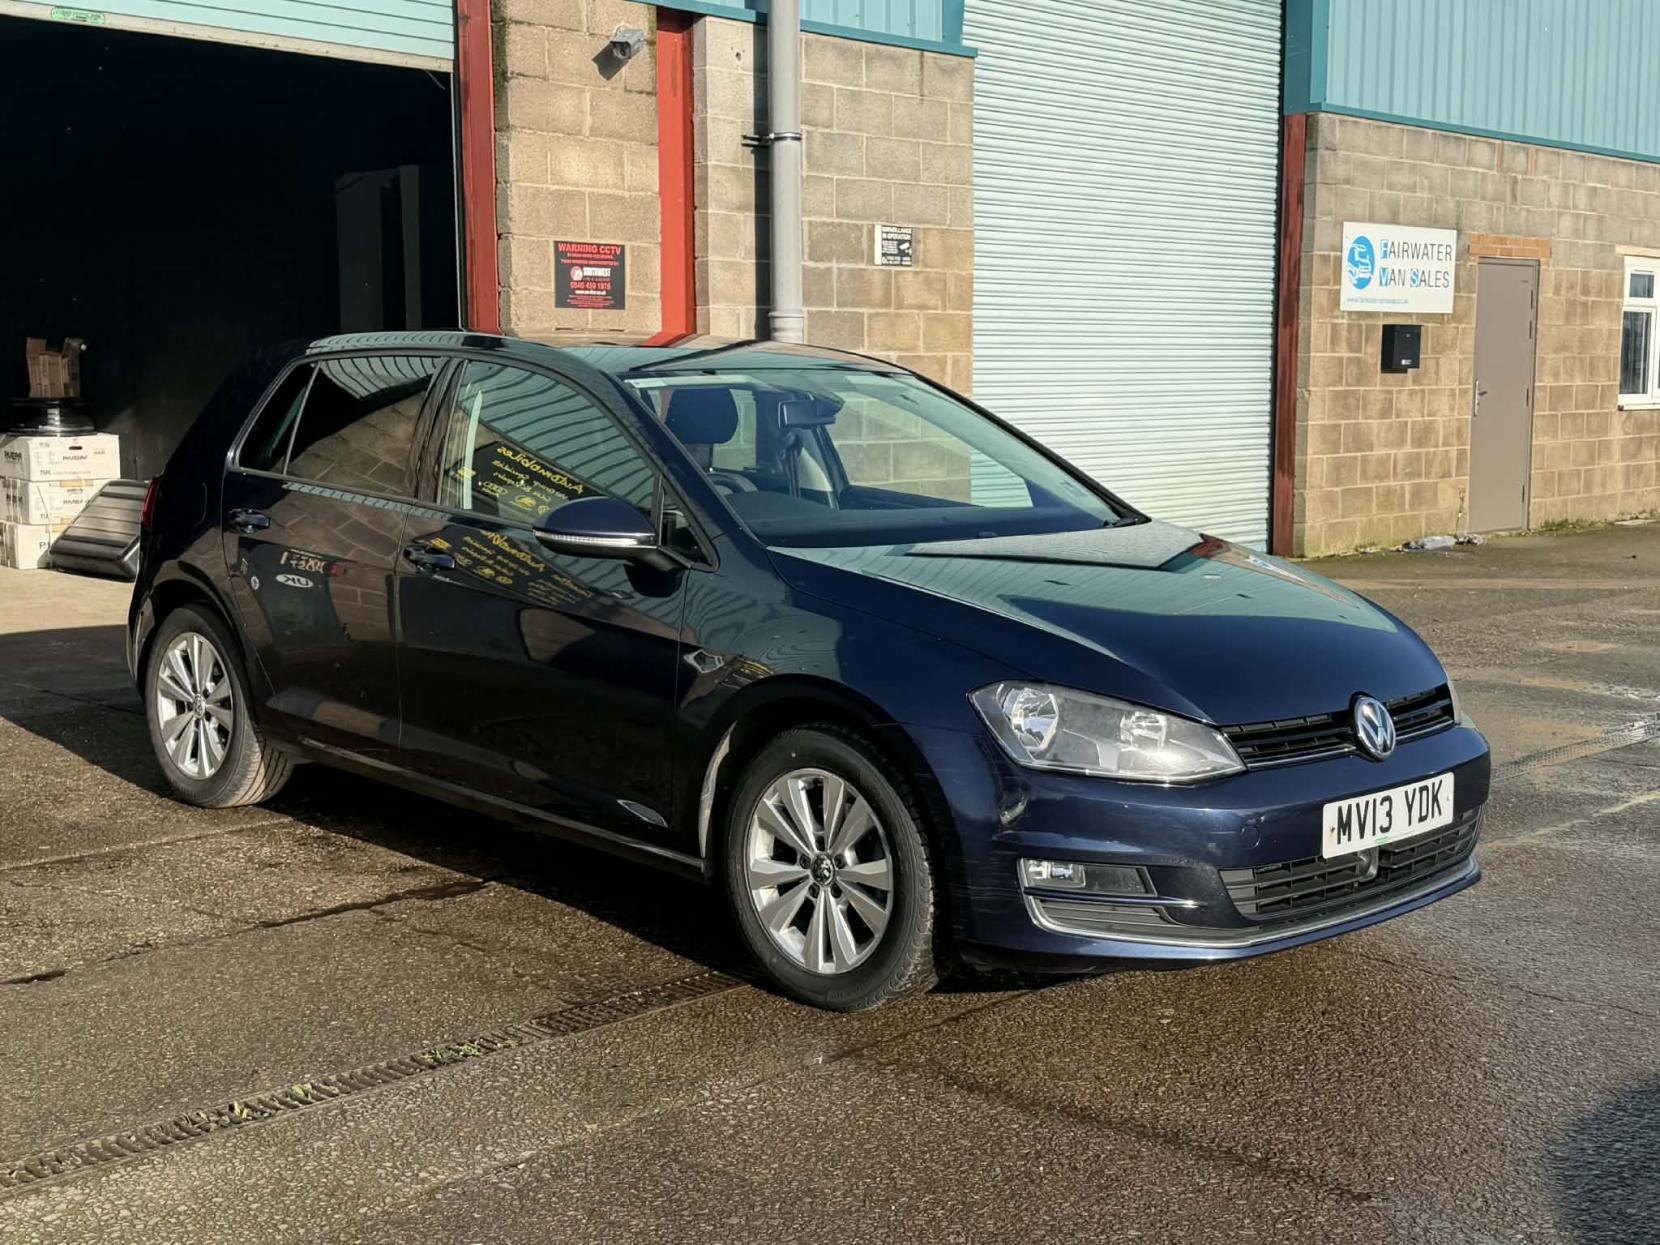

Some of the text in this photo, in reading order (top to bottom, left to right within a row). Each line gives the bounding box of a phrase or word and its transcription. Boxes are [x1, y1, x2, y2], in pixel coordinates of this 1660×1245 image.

[558, 243, 621, 255] WARNING CCTV
[1380, 239, 1453, 262] FAIRWATER
[1379, 267, 1450, 288] VAN SALES
[1337, 779, 1443, 844] MV13 YDK
